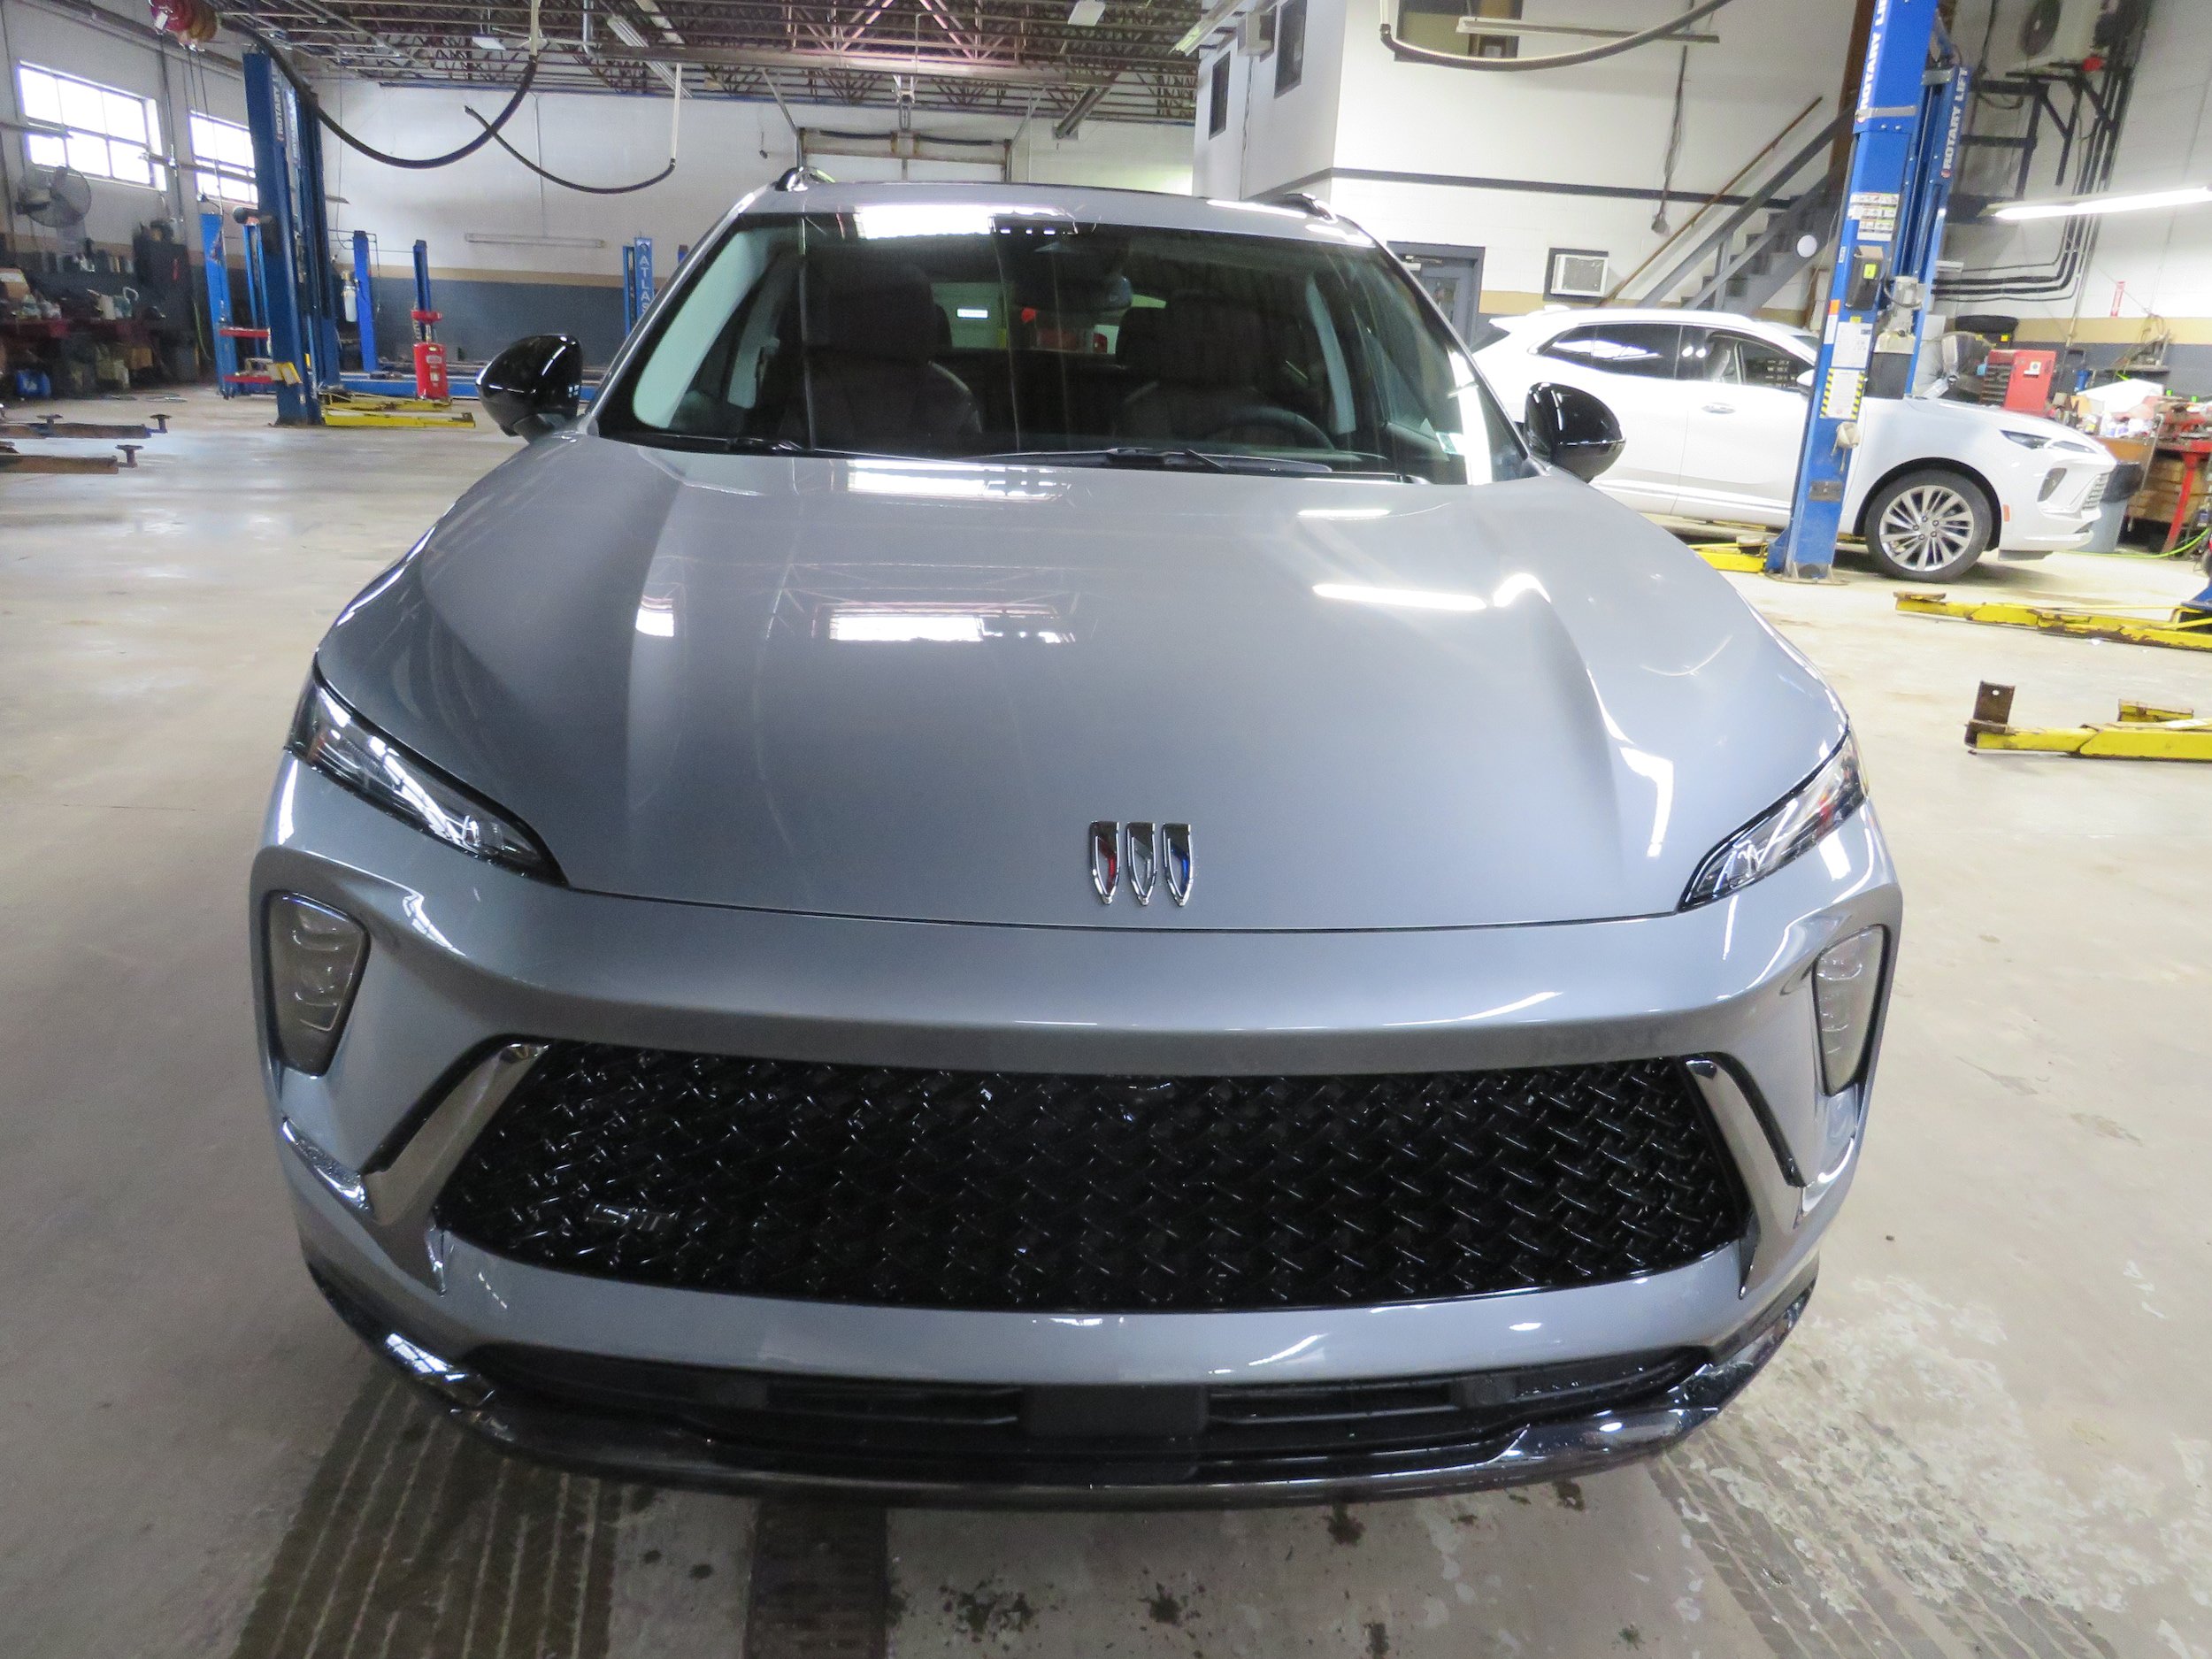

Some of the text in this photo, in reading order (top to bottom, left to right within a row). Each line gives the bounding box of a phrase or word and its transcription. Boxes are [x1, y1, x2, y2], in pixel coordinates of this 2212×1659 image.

[1860, 32, 1881, 110] ROTARY
[1943, 67, 1969, 169] ROTARY LIFT
[640, 256, 650, 312] ATLAS
